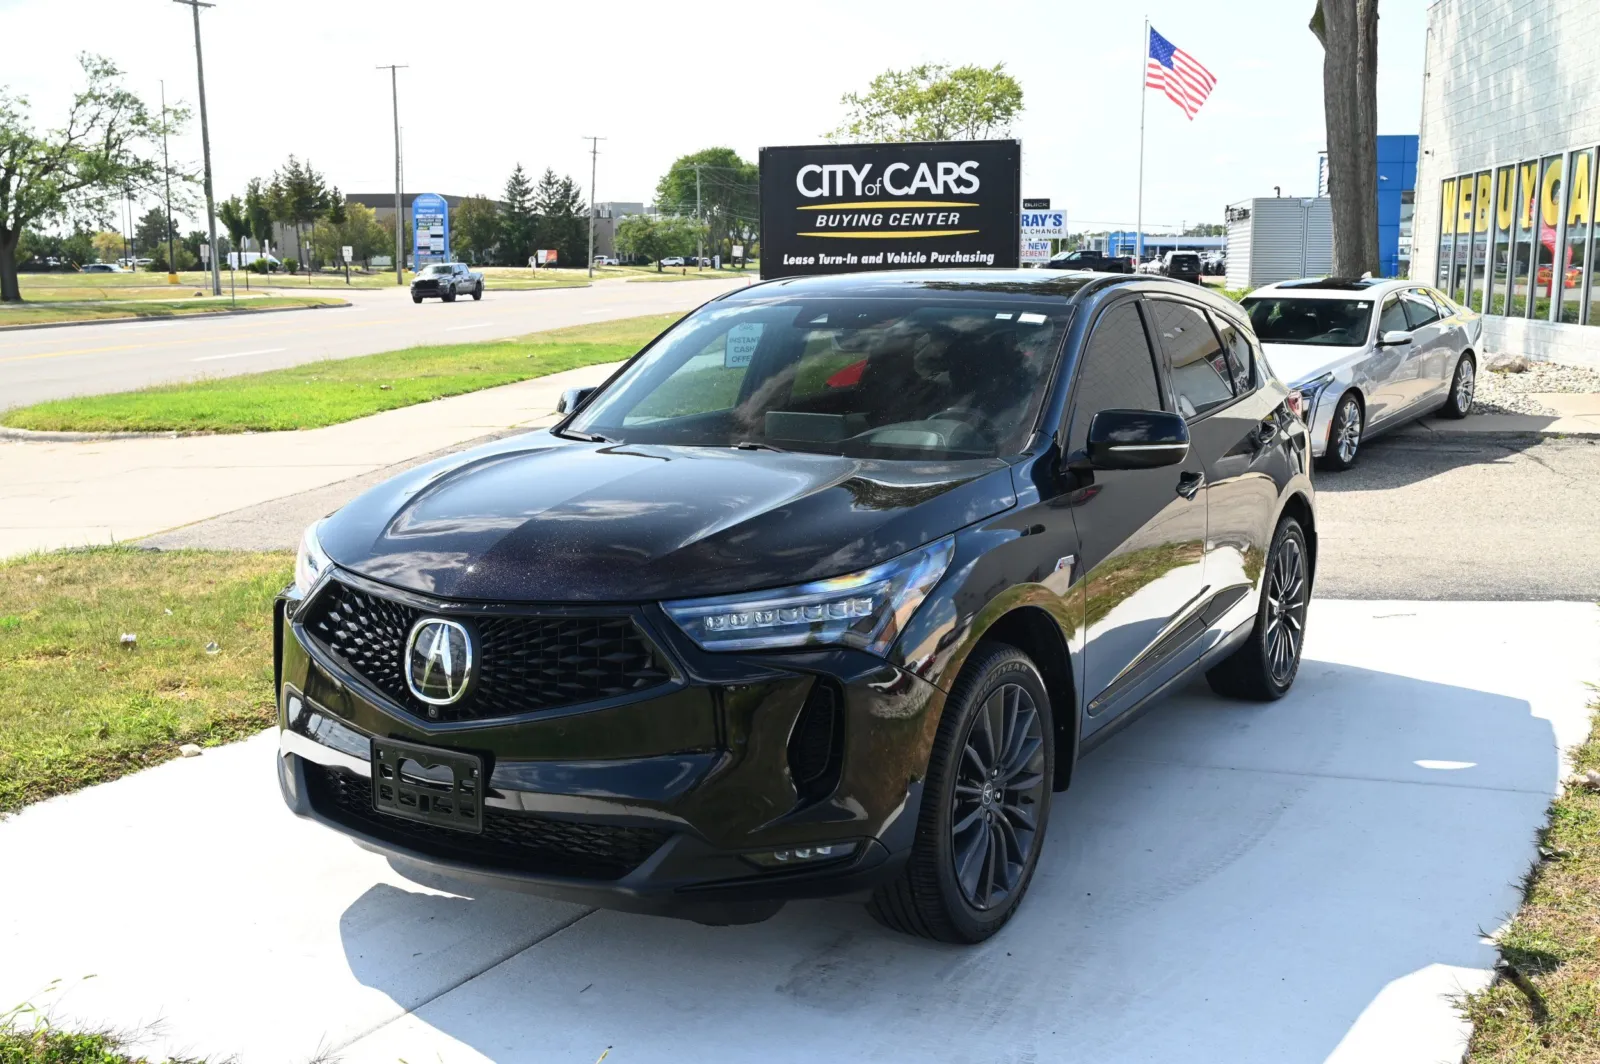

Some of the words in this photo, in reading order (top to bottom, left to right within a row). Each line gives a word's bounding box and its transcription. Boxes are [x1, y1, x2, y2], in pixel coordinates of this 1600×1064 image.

[796, 163, 873, 198] CITY
[865, 177, 882, 196] of
[883, 160, 980, 196] CARS
[1541, 153, 1600, 226] CA
[815, 213, 883, 227] BUYING
[888, 212, 960, 226] CENTER
[1028, 242, 1048, 250] NEW
[783, 253, 815, 265] Lease
[819, 253, 858, 265] Turn-In
[861, 252, 883, 265] and
[887, 252, 927, 264] Vehicle
[930, 251, 995, 266] Purchasing
[731, 355, 752, 363] OFFE
